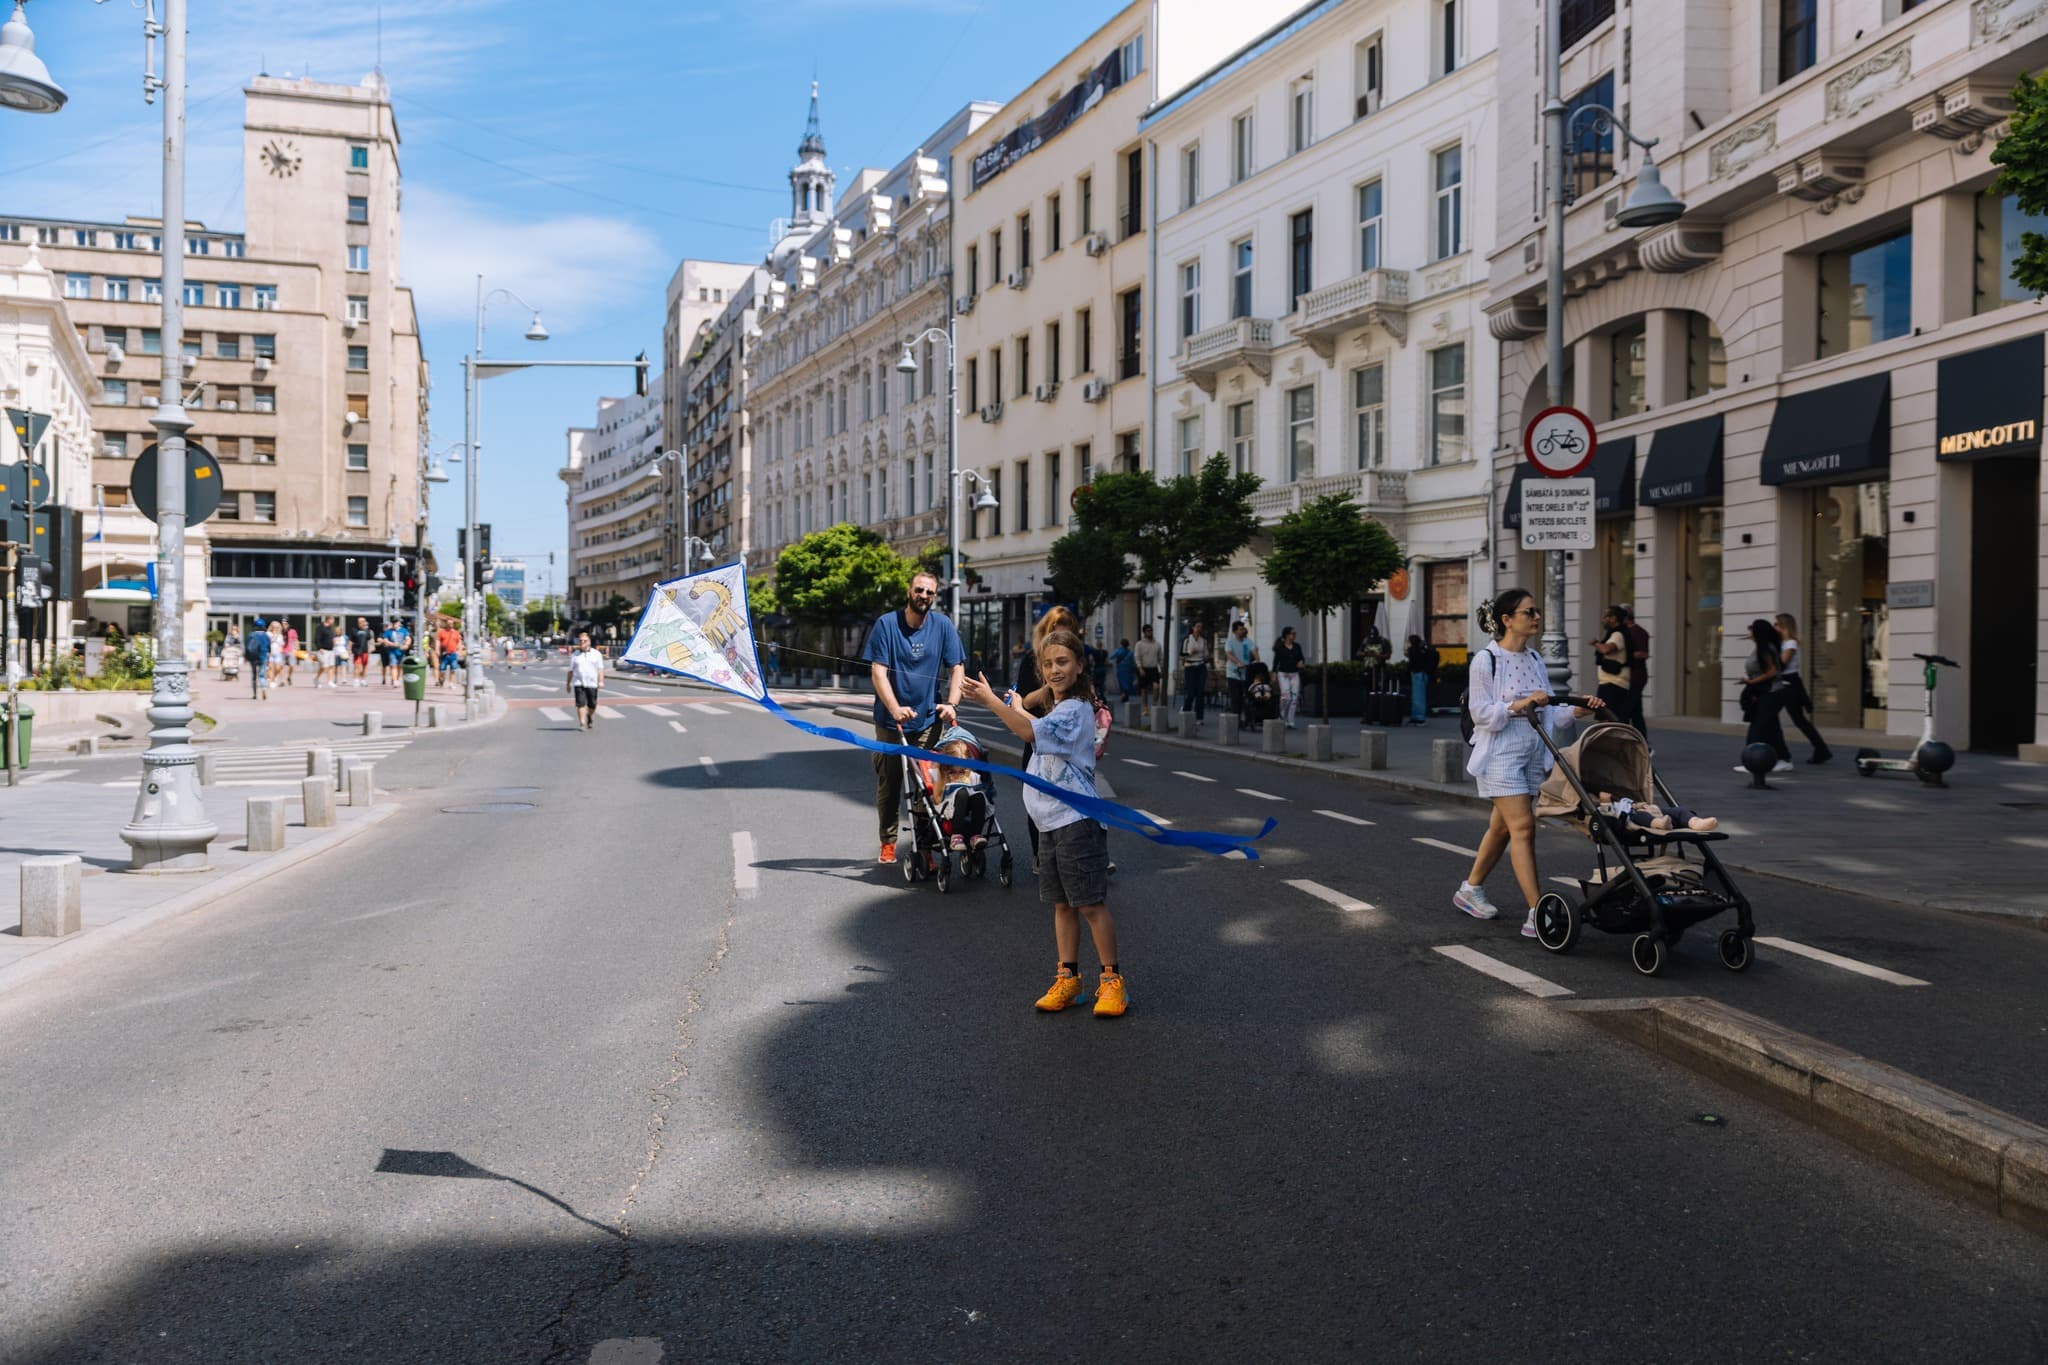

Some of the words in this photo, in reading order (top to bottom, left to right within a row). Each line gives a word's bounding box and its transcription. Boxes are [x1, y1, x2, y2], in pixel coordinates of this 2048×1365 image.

[1545, 503, 1566, 512] ORELE
[1529, 517, 1555, 526] INTERZIS
[1556, 517, 1588, 526] BICICLETE
[1545, 531, 1579, 540] TROTINETE
